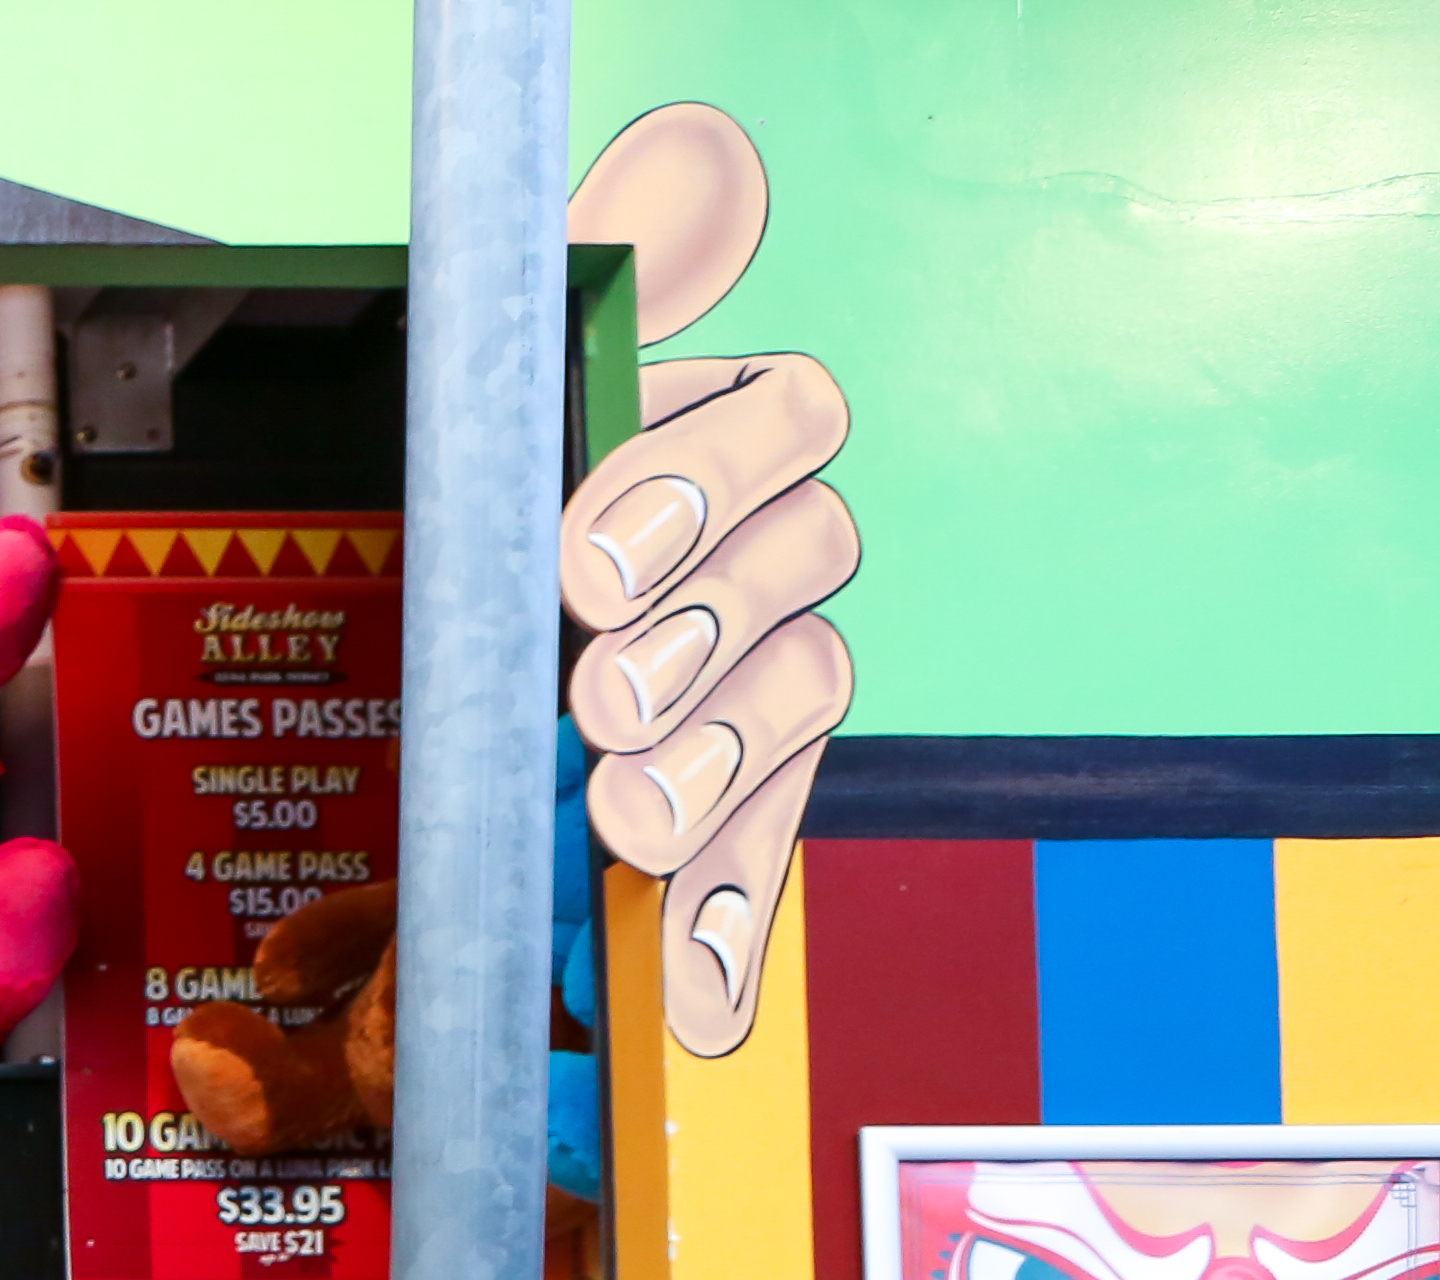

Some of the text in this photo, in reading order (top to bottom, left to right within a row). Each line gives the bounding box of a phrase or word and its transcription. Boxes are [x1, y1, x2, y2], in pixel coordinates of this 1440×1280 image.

[193, 601, 346, 633] Sideshow
[201, 634, 340, 663] ALLEY
[133, 699, 264, 739] GAMES
[192, 765, 361, 795] SINGLE PLAY
[233, 799, 317, 829] $5.00
[185, 851, 371, 881] 4 GAME PASS
[145, 966, 170, 1001] 8
[146, 1007, 160, 1026] 8
[102, 1112, 146, 1152] 10
[104, 1158, 127, 1179] 10
[129, 1158, 181, 1179] GAME
[181, 1158, 227, 1179] PASS
[230, 1159, 257, 1179] ON
[259, 1159, 273, 1179] A
[327, 1159, 375, 1179] PARK
[216, 1185, 345, 1225] $33.95
[234, 1229, 325, 1255] SAVE $21
